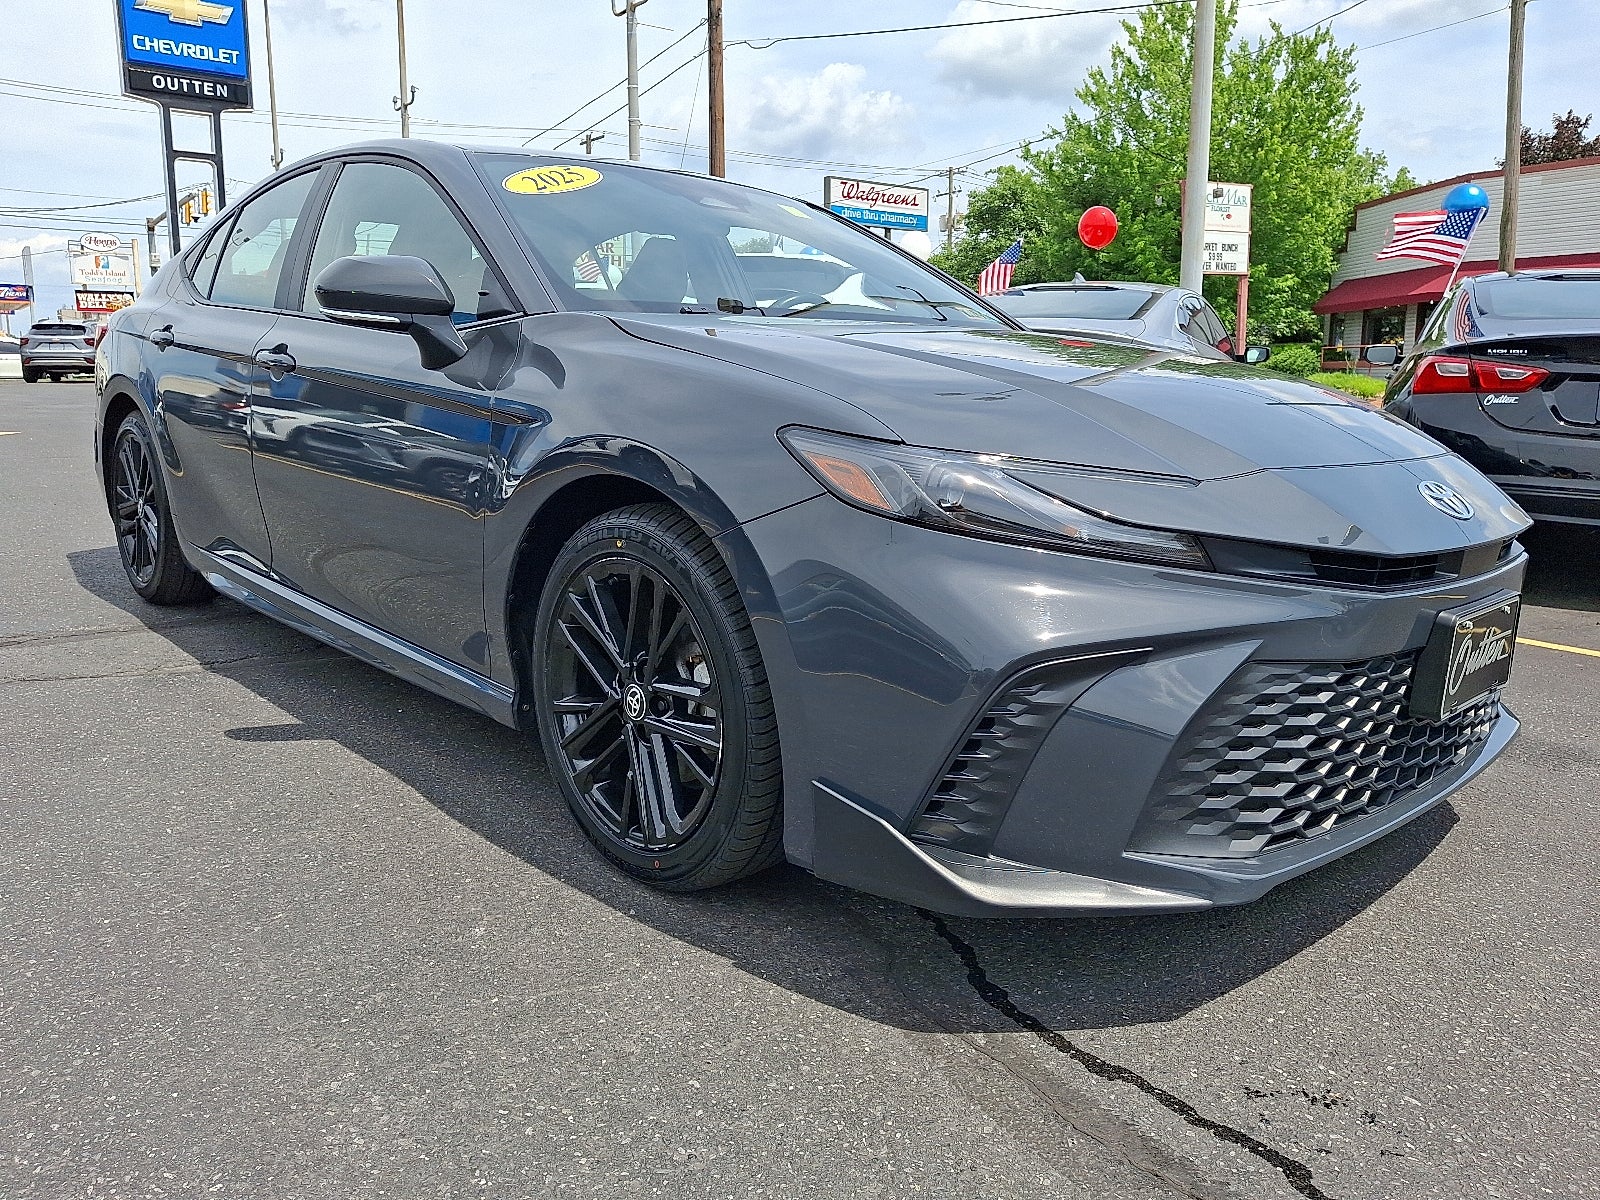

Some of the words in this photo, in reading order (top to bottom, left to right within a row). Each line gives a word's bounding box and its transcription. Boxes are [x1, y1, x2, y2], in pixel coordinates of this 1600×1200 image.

[132, 34, 240, 65] CHEVROLET
[152, 75, 228, 98] OUTTEN
[521, 167, 585, 191] 2025
[840, 181, 920, 208] Walgreens
[841, 207, 862, 219] drive
[863, 209, 879, 221] thru
[880, 213, 918, 227] pharmacy
[1211, 205, 1231, 213] FLORIST
[1203, 242, 1217, 251] RKET
[1221, 243, 1239, 252] BUNCH
[79, 268, 103, 276] Todd's
[105, 269, 126, 277] Island
[1215, 262, 1237, 271] WANTED
[79, 301, 107, 309] DELI
[1484, 394, 1520, 406] Outten
[1448, 626, 1512, 696] Outten
